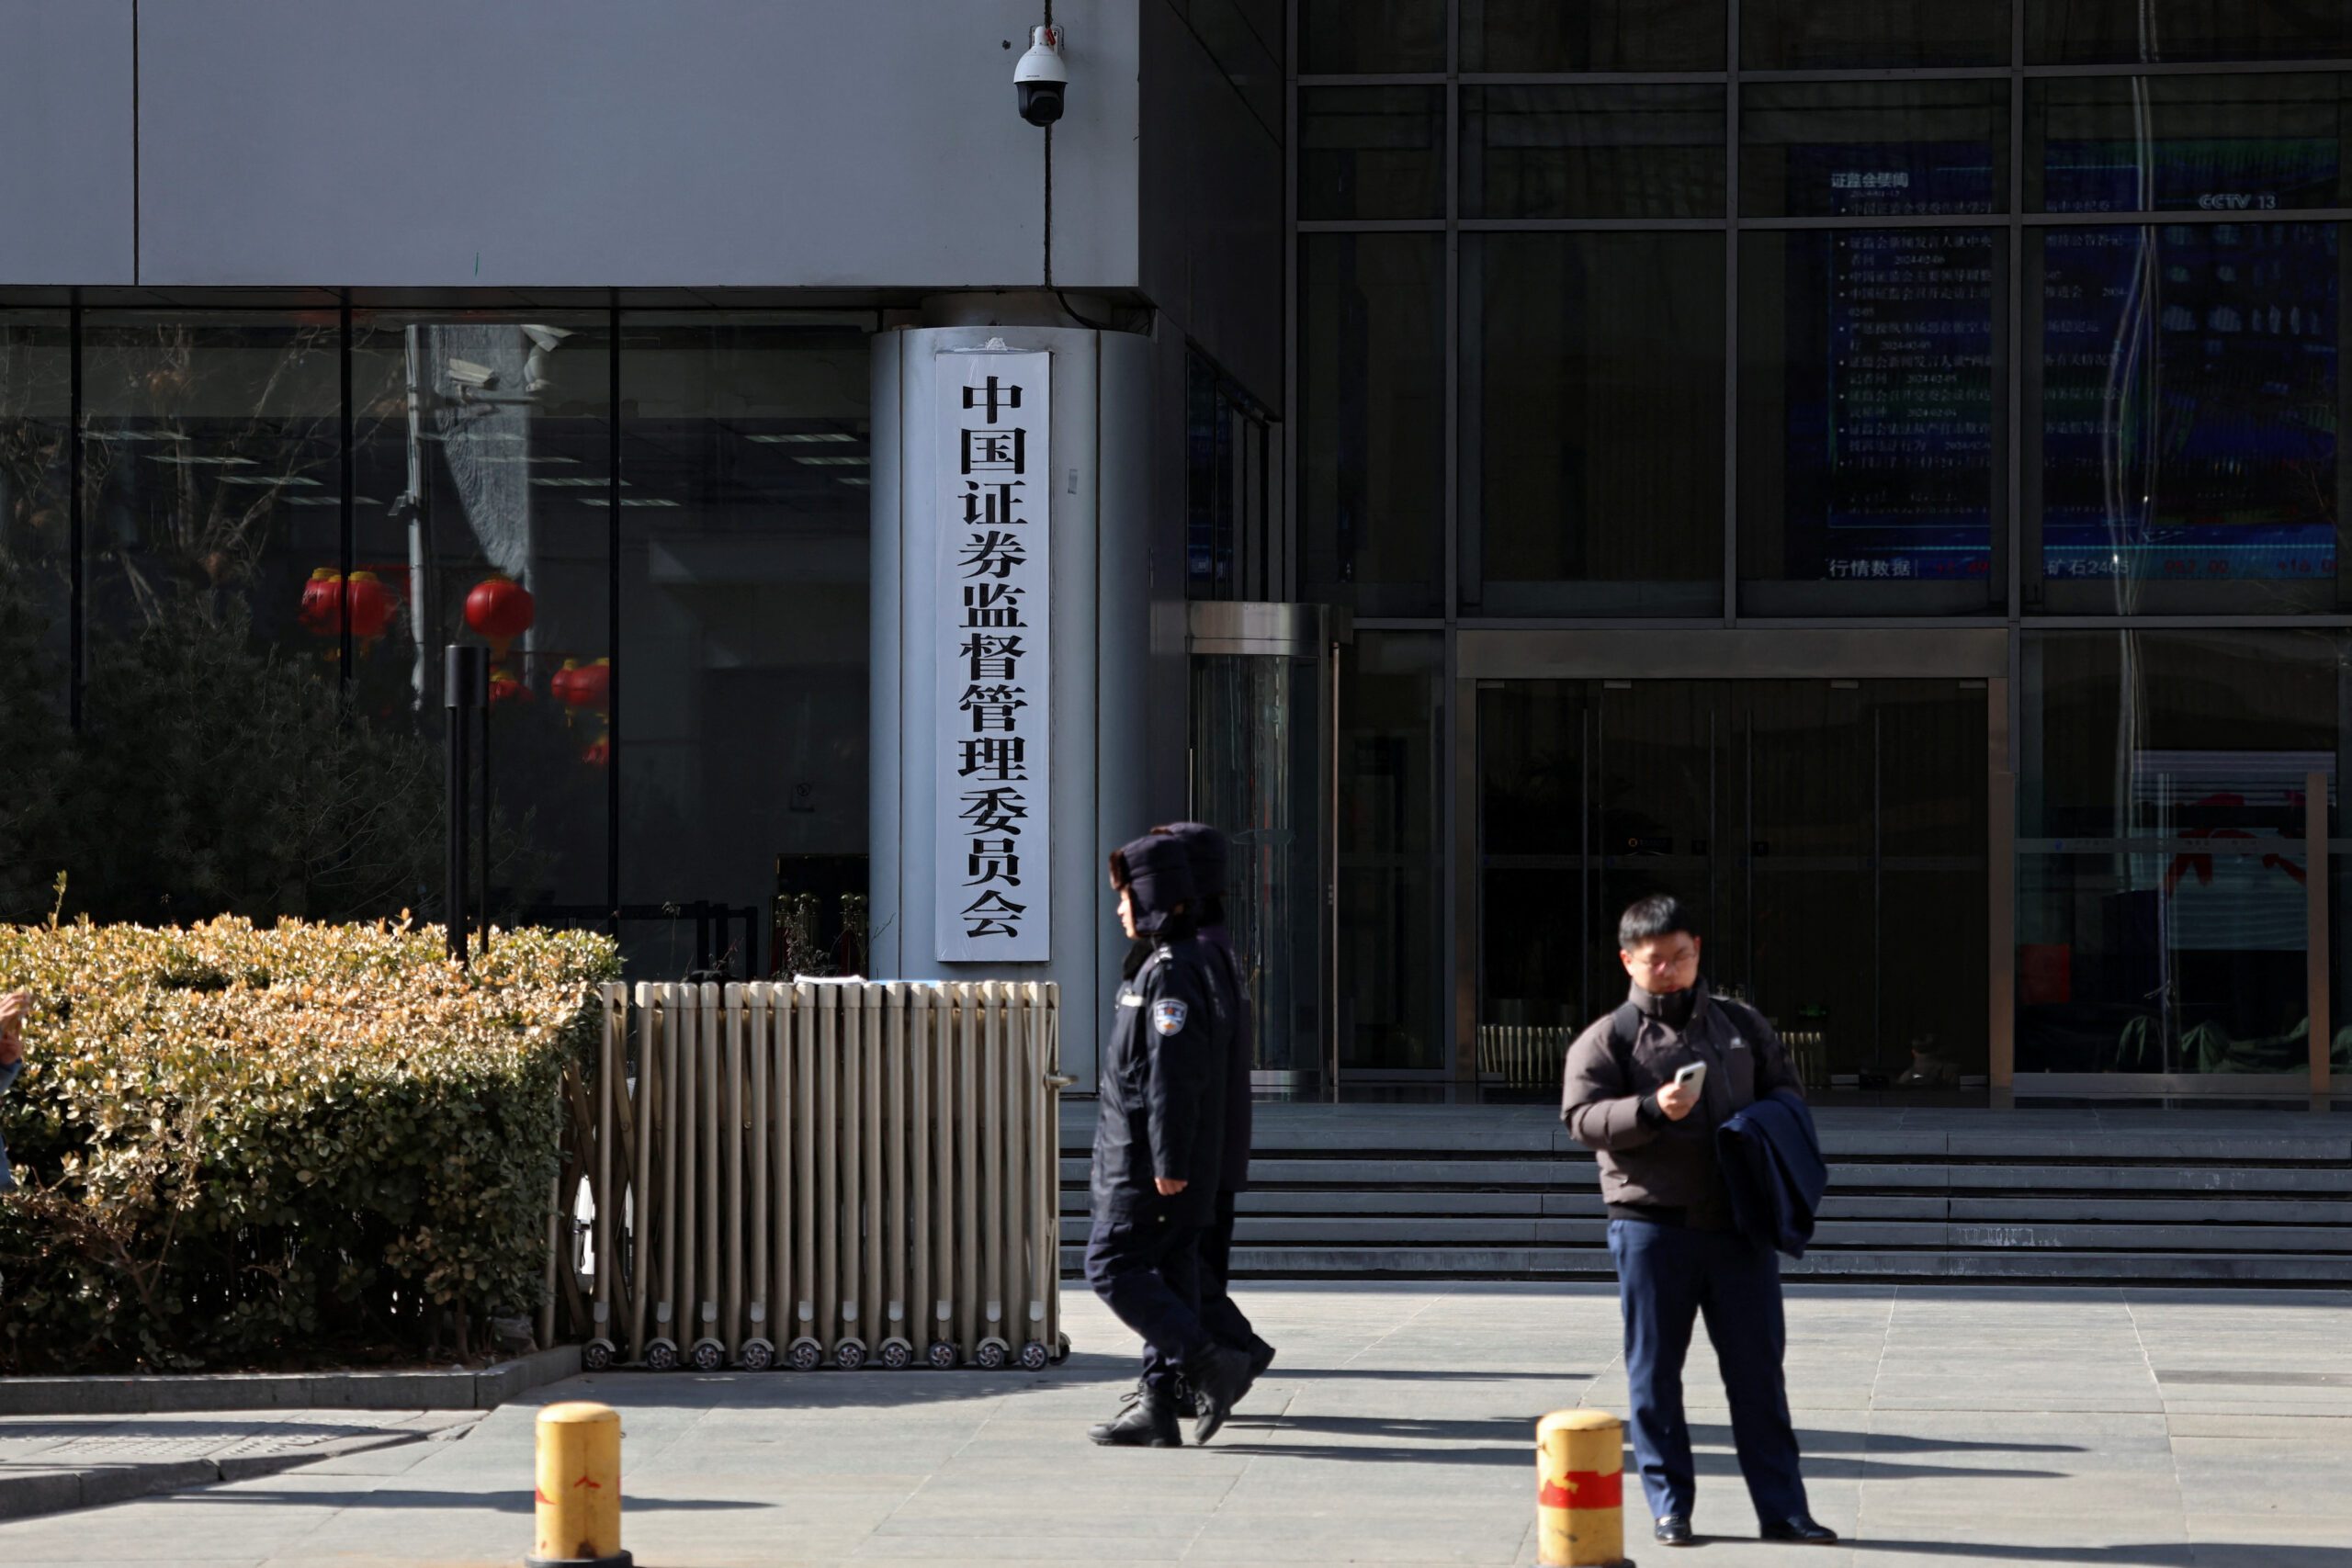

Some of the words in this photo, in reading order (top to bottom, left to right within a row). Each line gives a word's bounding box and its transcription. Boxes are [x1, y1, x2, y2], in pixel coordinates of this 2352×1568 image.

[1831, 172, 1909, 188] 证监会要闻
[2198, 194, 2252, 209] CCTV
[2258, 195, 2277, 209] 13
[1829, 558, 1911, 578] 行情数据
[956, 375, 1028, 940] 中国证券监督管理委员会
